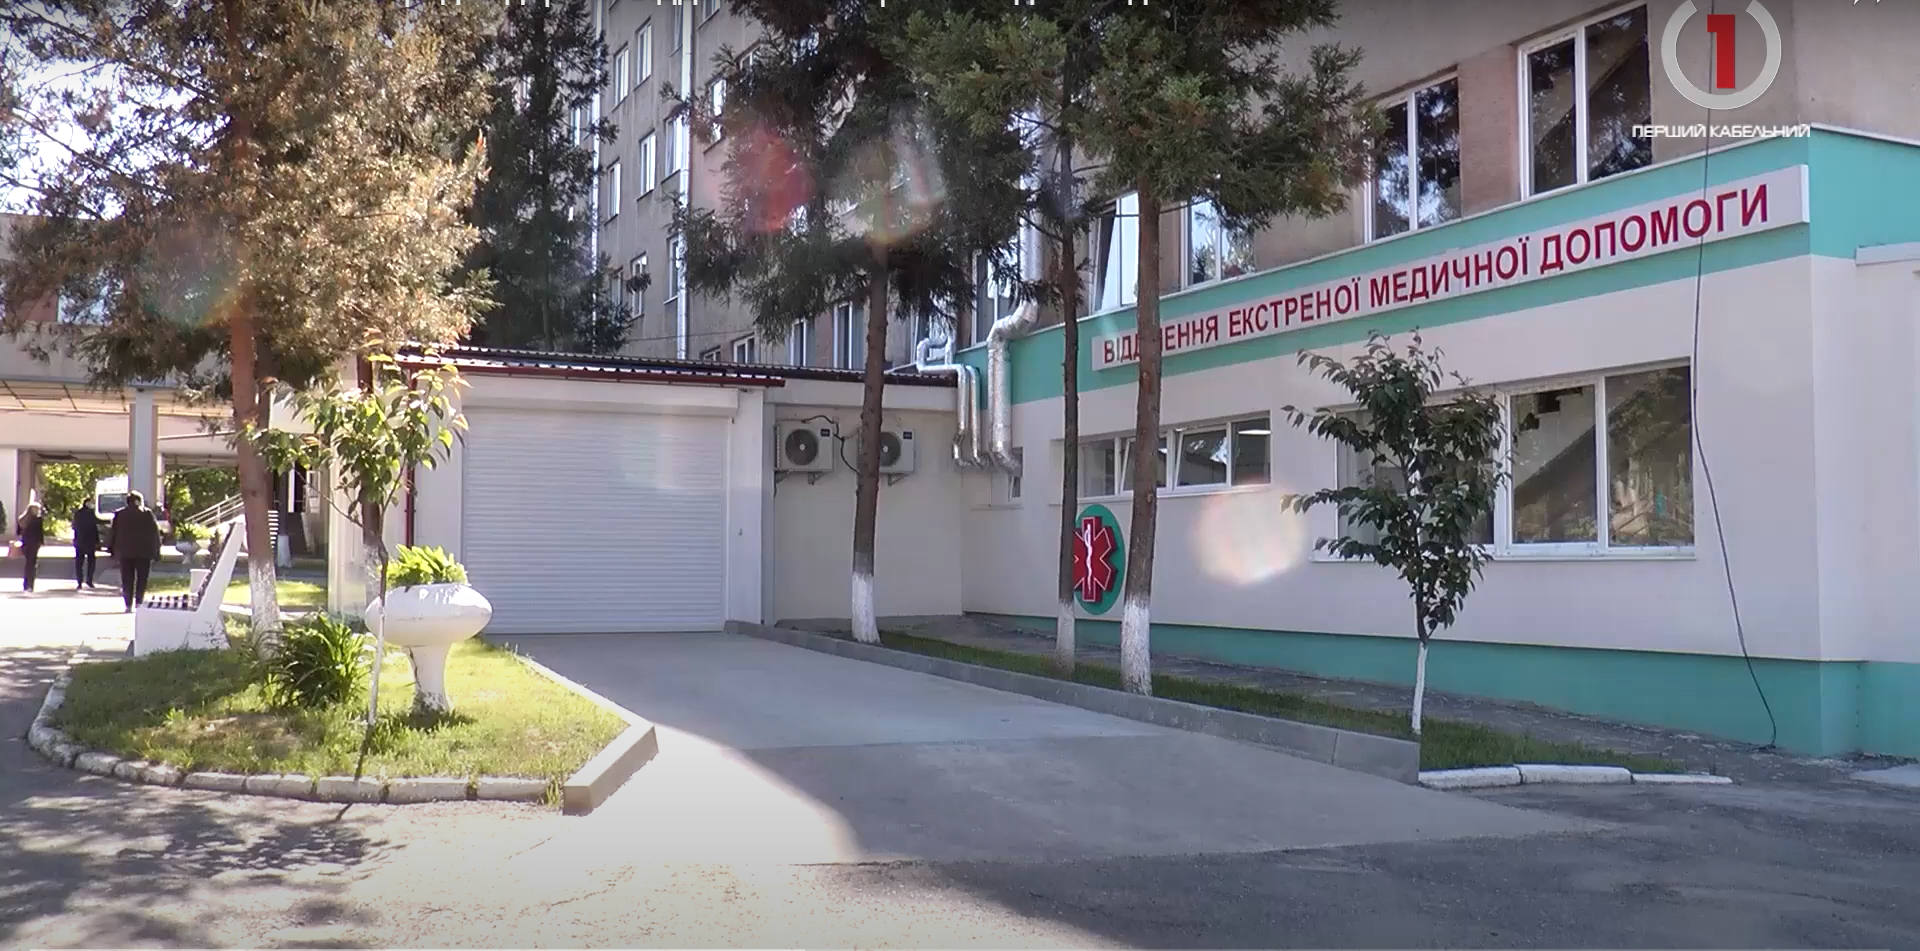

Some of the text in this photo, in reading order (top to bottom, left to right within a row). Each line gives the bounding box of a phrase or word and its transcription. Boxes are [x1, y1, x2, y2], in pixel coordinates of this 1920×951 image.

[1229, 276, 1361, 336] ЕКСТРЕНОЇ
[1370, 236, 1530, 308] МЕДИЧНОЇ
[1540, 184, 1768, 275] ДОПОМОГИ
